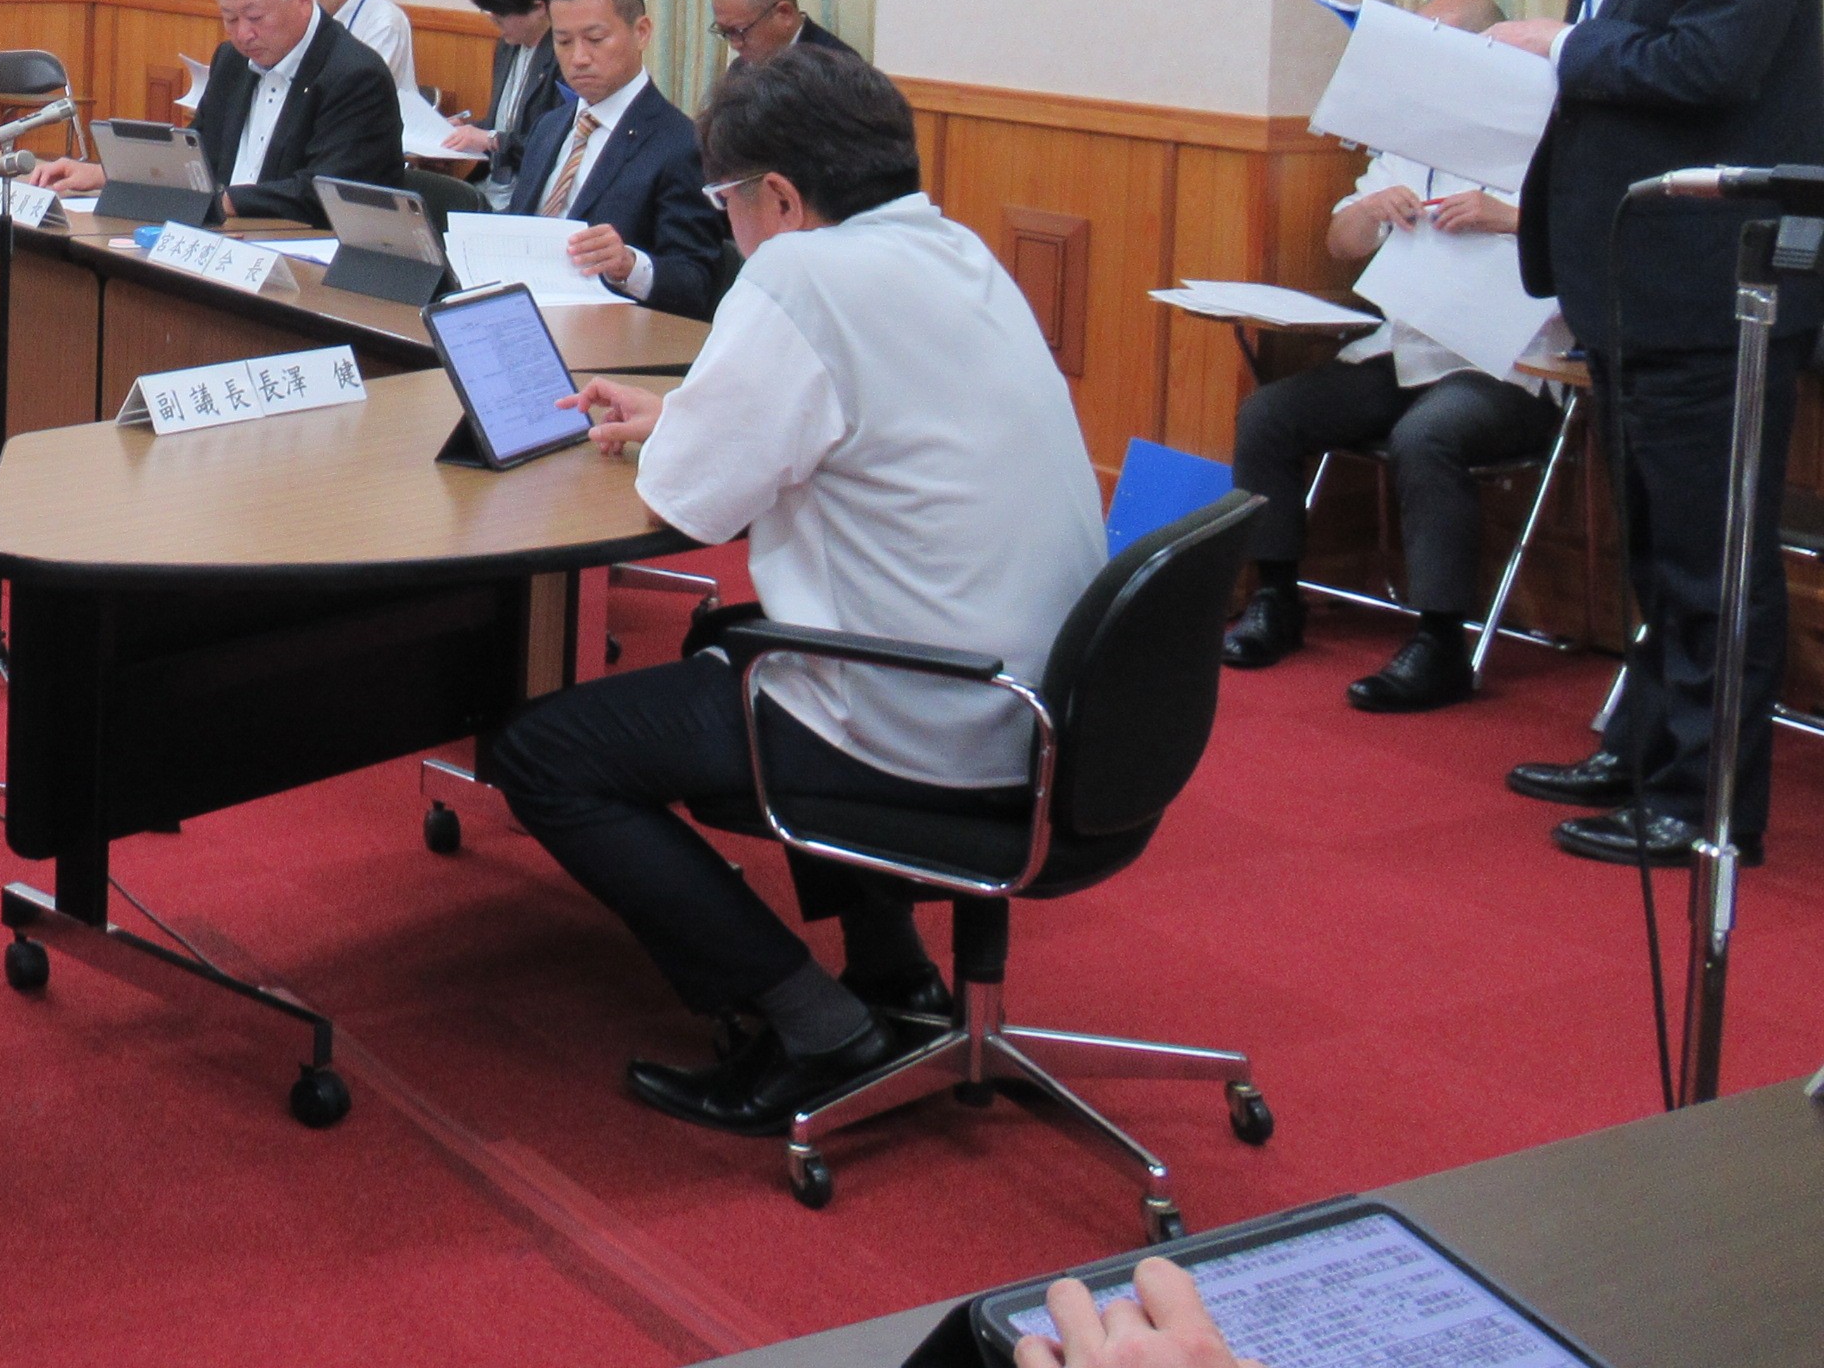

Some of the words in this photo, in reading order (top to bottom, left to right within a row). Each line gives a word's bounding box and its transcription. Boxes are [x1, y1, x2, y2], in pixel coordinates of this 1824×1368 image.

[157, 233, 216, 266] 宮本秀憲
[215, 249, 264, 282] 会長
[155, 378, 251, 422] 副議長
[258, 358, 360, 403] 長澤健
